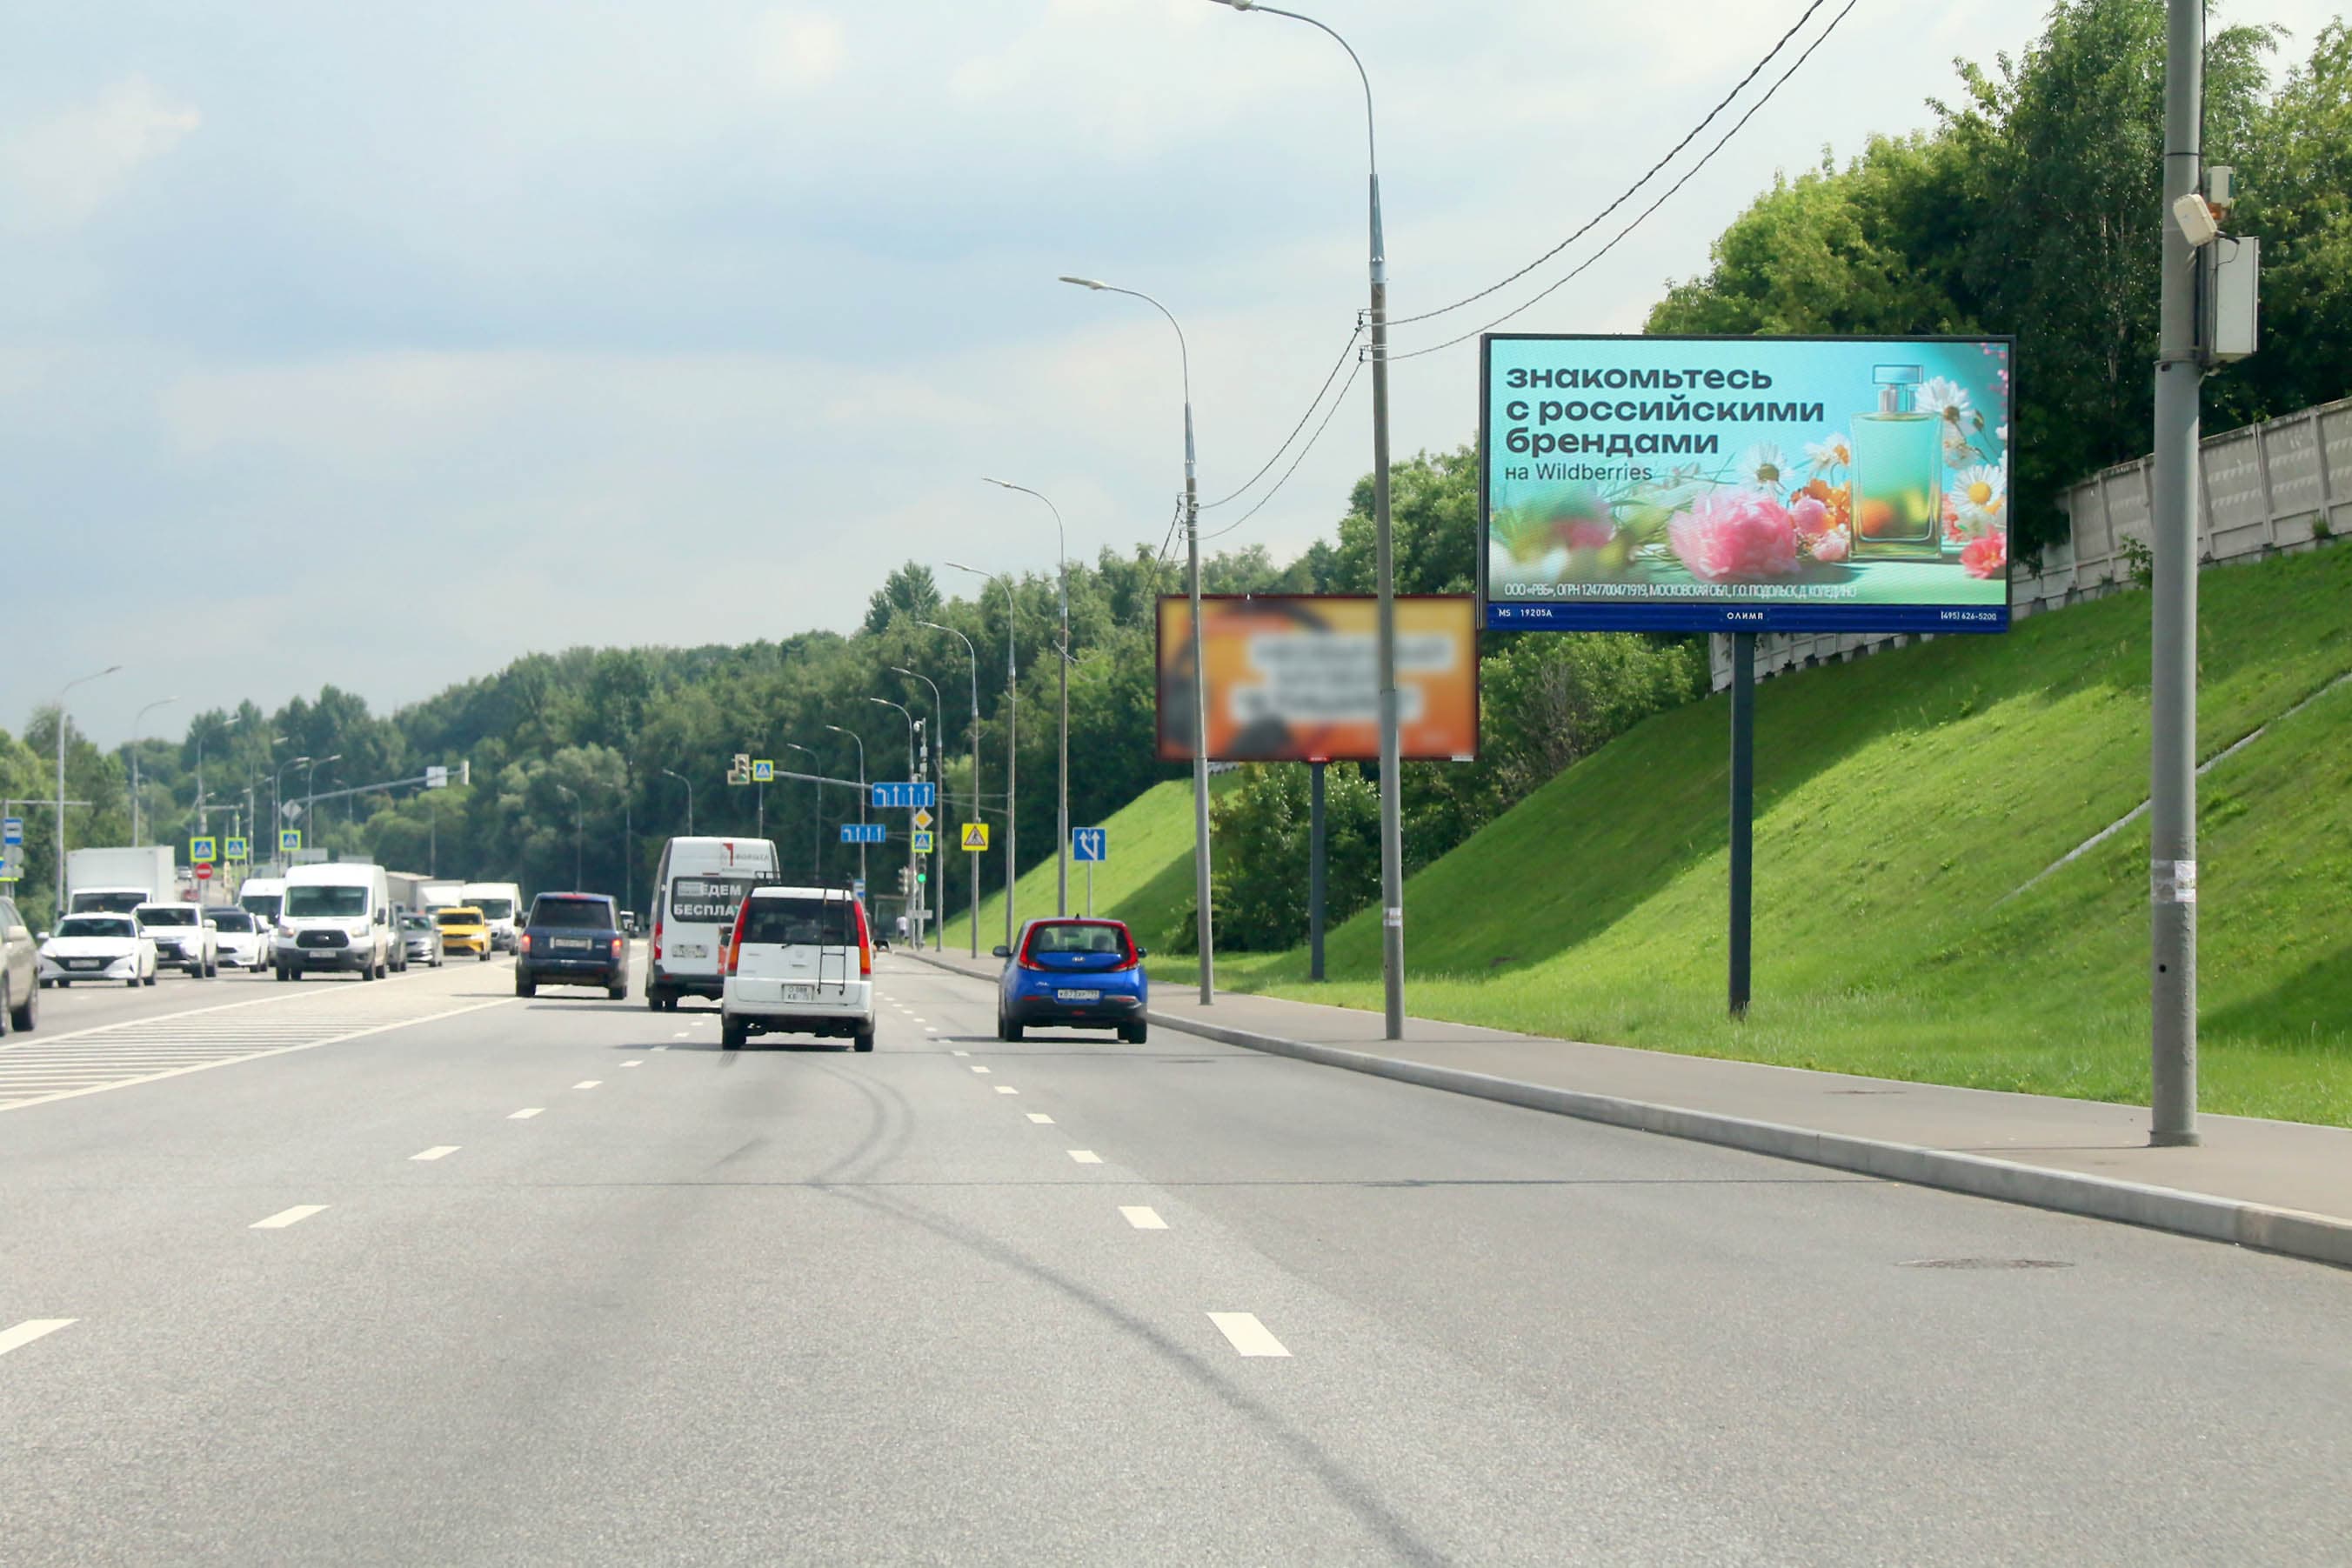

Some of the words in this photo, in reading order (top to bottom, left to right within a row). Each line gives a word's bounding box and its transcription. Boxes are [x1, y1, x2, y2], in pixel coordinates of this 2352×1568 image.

[1506, 368, 1773, 390] знакомьтесь
[1506, 401, 1529, 421] с
[1539, 394, 1824, 425] российскими
[1506, 427, 1718, 457] брендами
[1506, 466, 1528, 481] на
[1535, 463, 1653, 481] Wildberries
[1504, 584, 1526, 596] ООО
[1556, 584, 1580, 596] ОГРН
[1649, 584, 1709, 597] МОСКОВСКАЯ
[1808, 585, 1857, 598] КОЛЕДИНО
[1499, 609, 1511, 617] MS
[1520, 609, 1553, 617] 19205A
[1727, 611, 1763, 620] ОЛИМП
[1941, 611, 1960, 620] (495)
[1961, 612, 1997, 621] 626-5200
